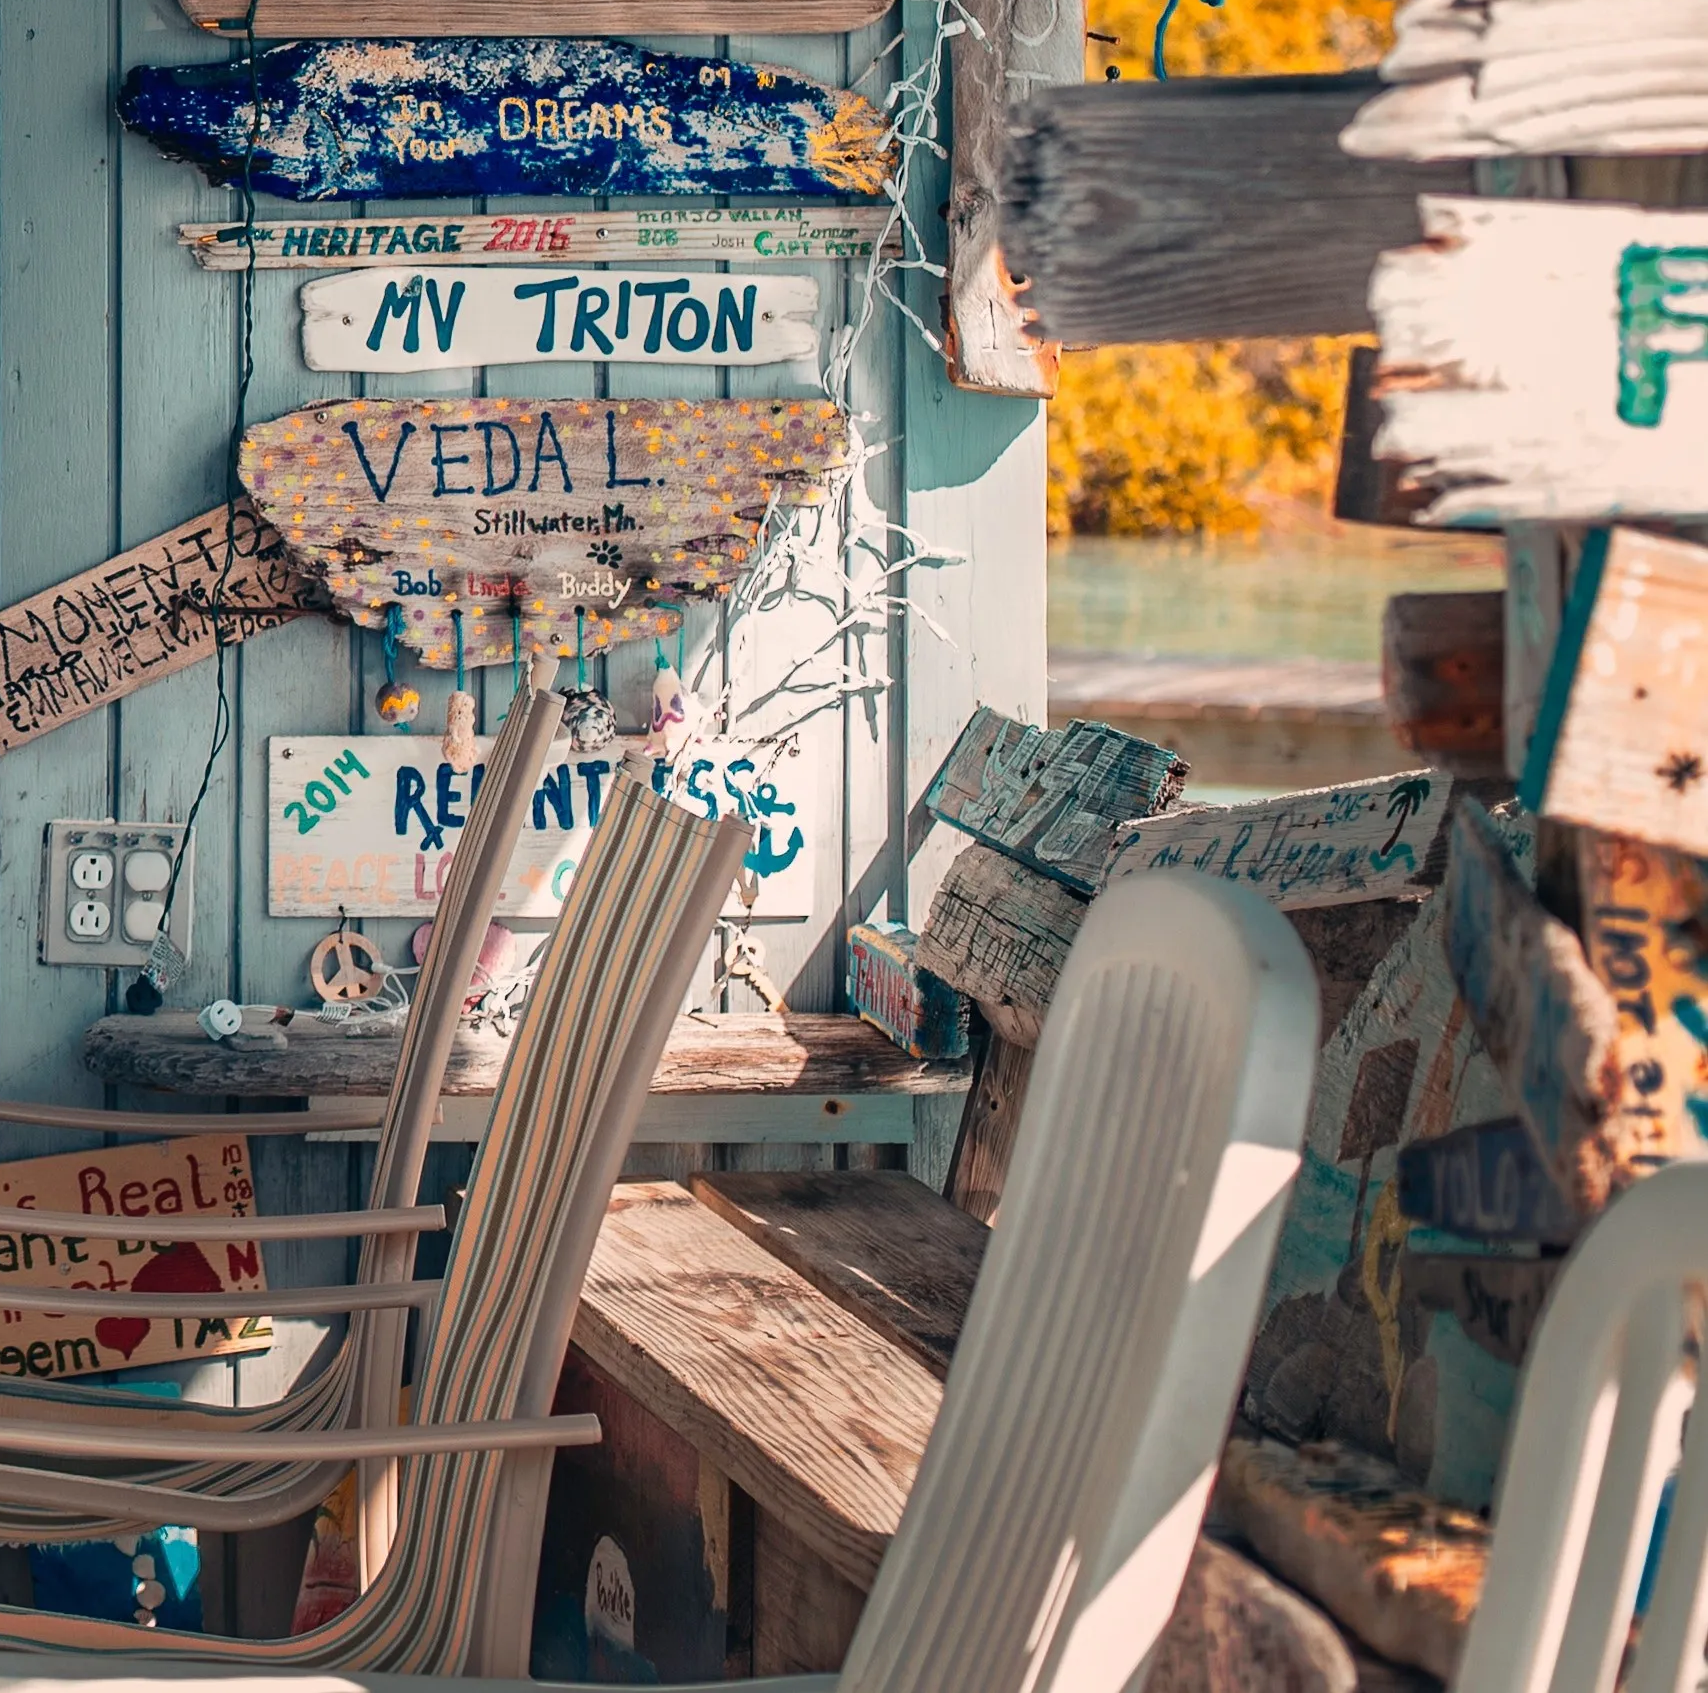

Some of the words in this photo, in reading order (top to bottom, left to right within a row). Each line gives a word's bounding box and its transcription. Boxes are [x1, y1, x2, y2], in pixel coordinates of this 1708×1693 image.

[498, 96, 673, 143] DREAMS
[282, 223, 466, 258] HERITAGE
[482, 216, 577, 253] 2016
[365, 277, 466, 355] MV
[514, 274, 760, 357] TRITON
[340, 411, 574, 505] VEDA
[604, 409, 668, 491] L.
[391, 568, 443, 597] Bob
[557, 568, 634, 610] Buddy
[282, 748, 372, 837] 2014
[271, 854, 399, 905] PEACE
[76, 1152, 219, 1220] Real
